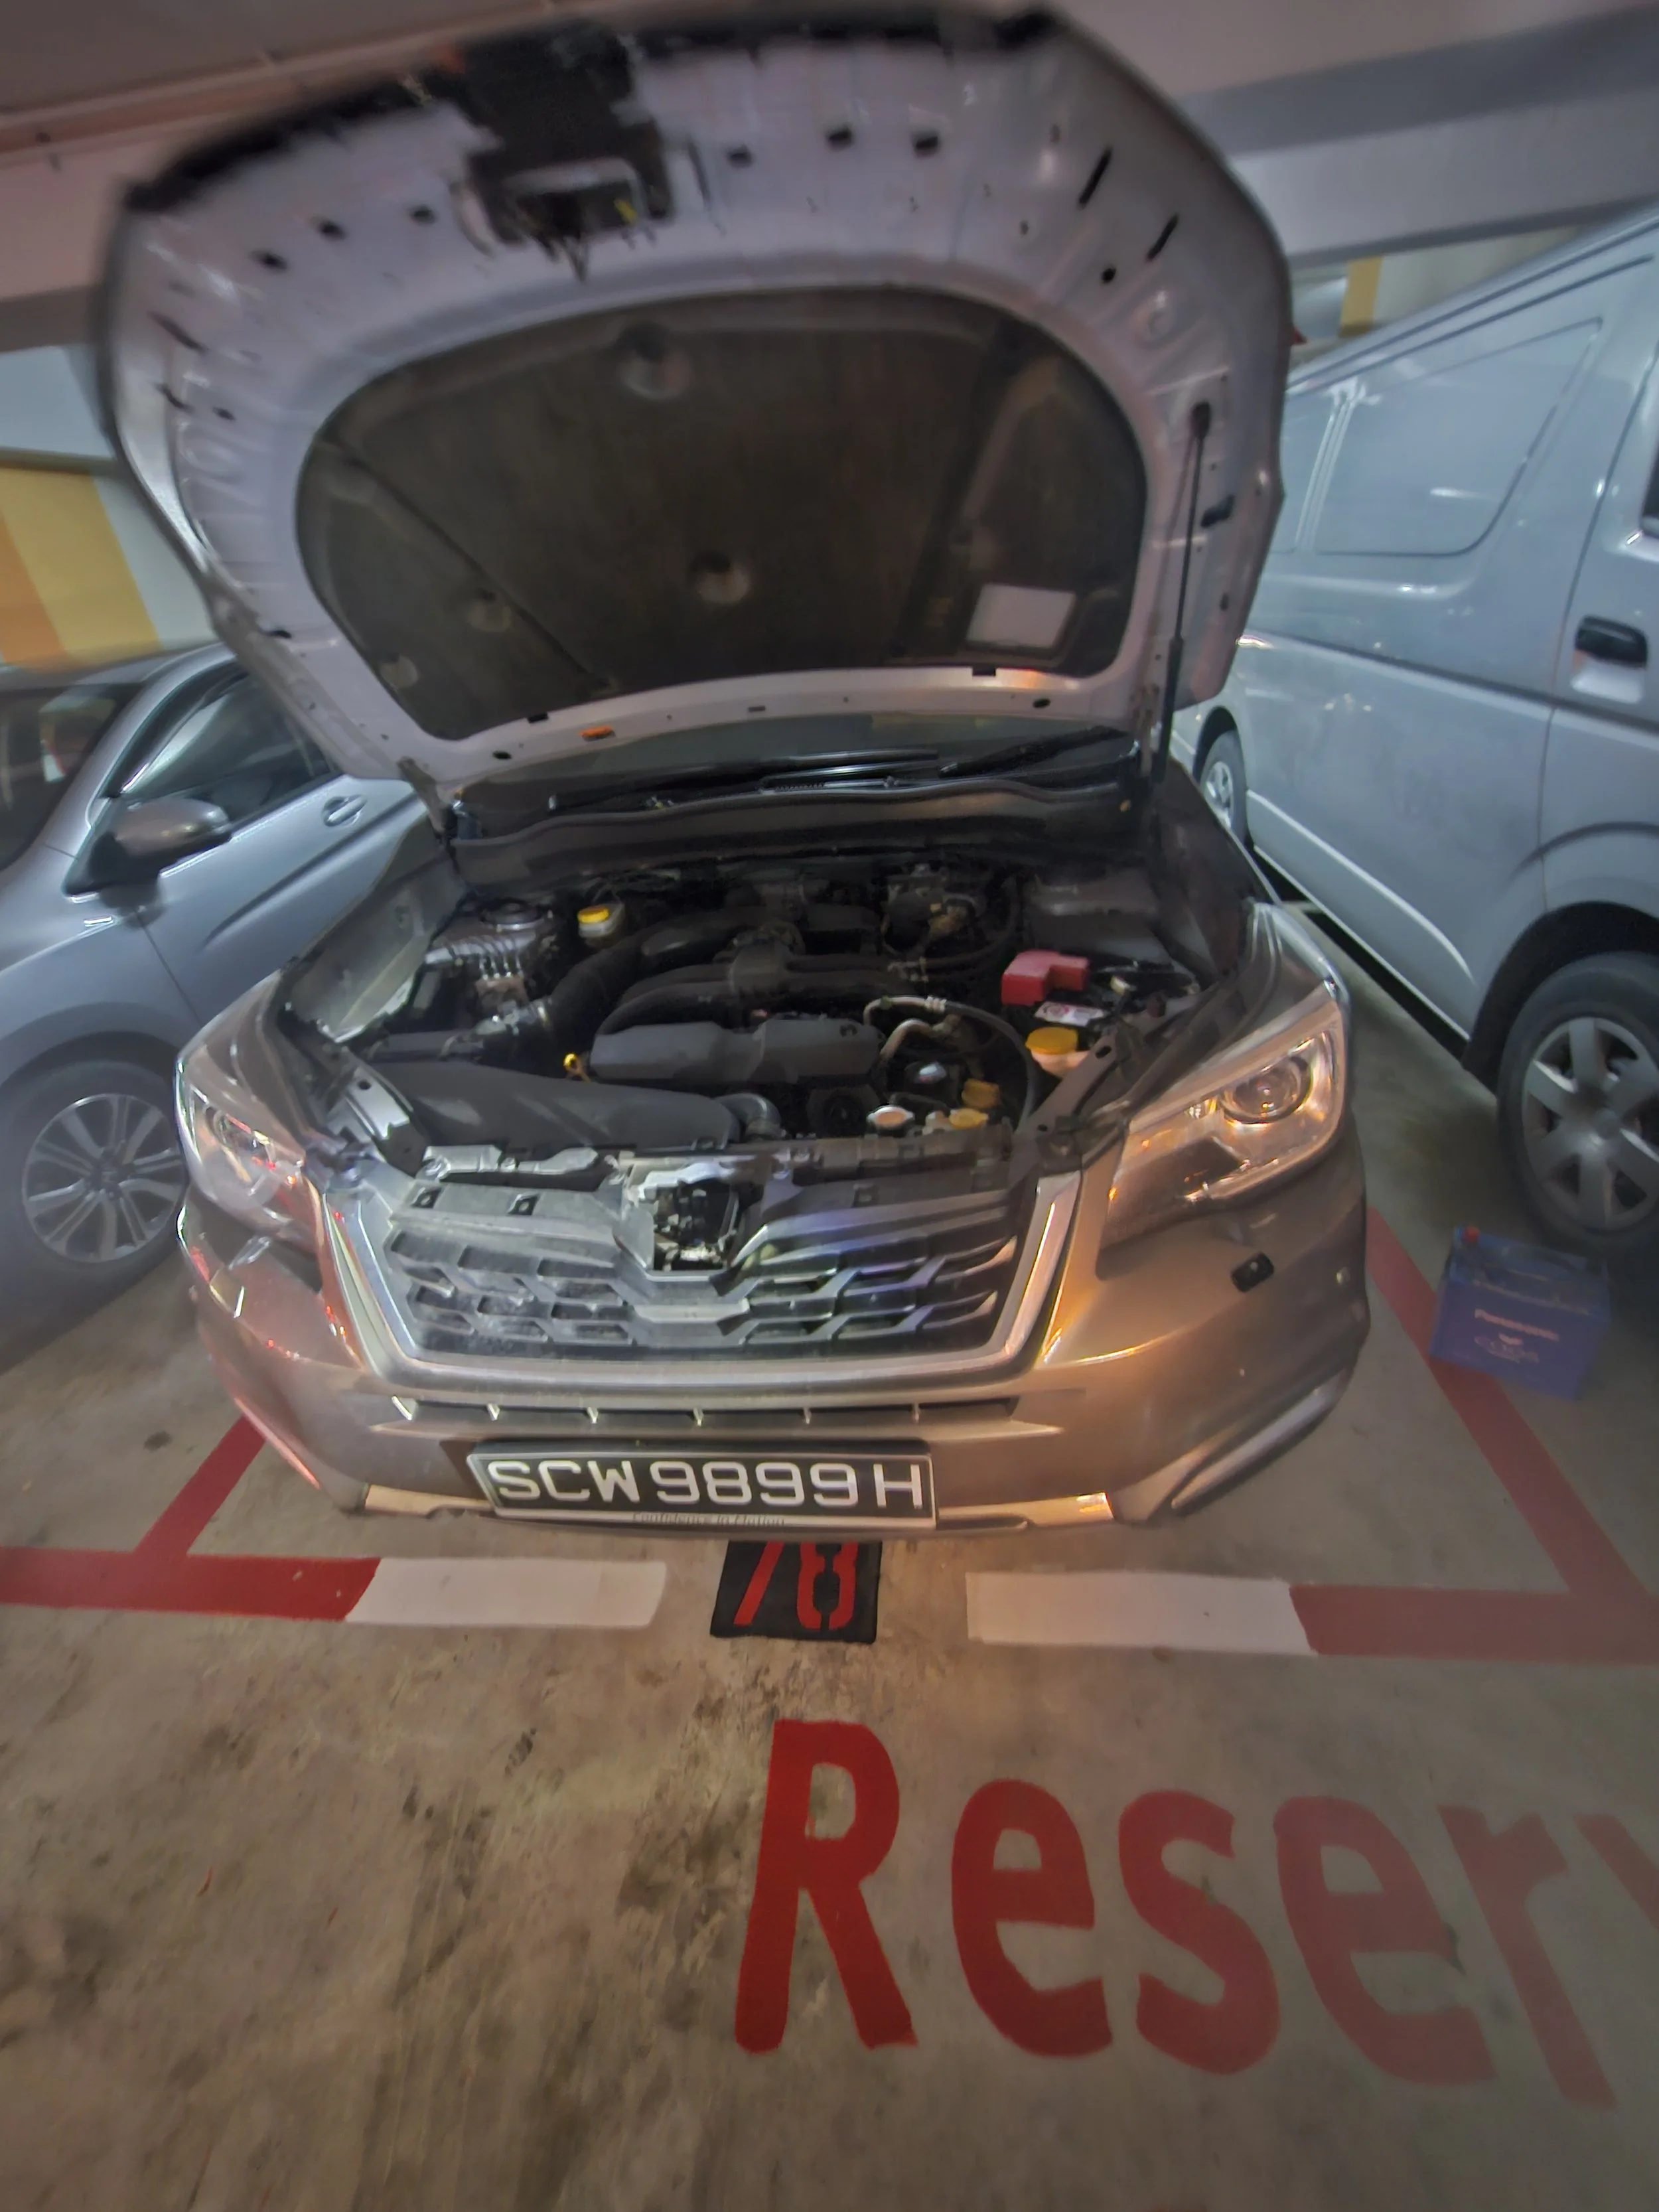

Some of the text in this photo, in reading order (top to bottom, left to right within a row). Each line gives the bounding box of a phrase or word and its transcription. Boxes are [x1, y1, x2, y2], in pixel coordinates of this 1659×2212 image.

[488, 1460, 924, 1509] SCW 9899 H
